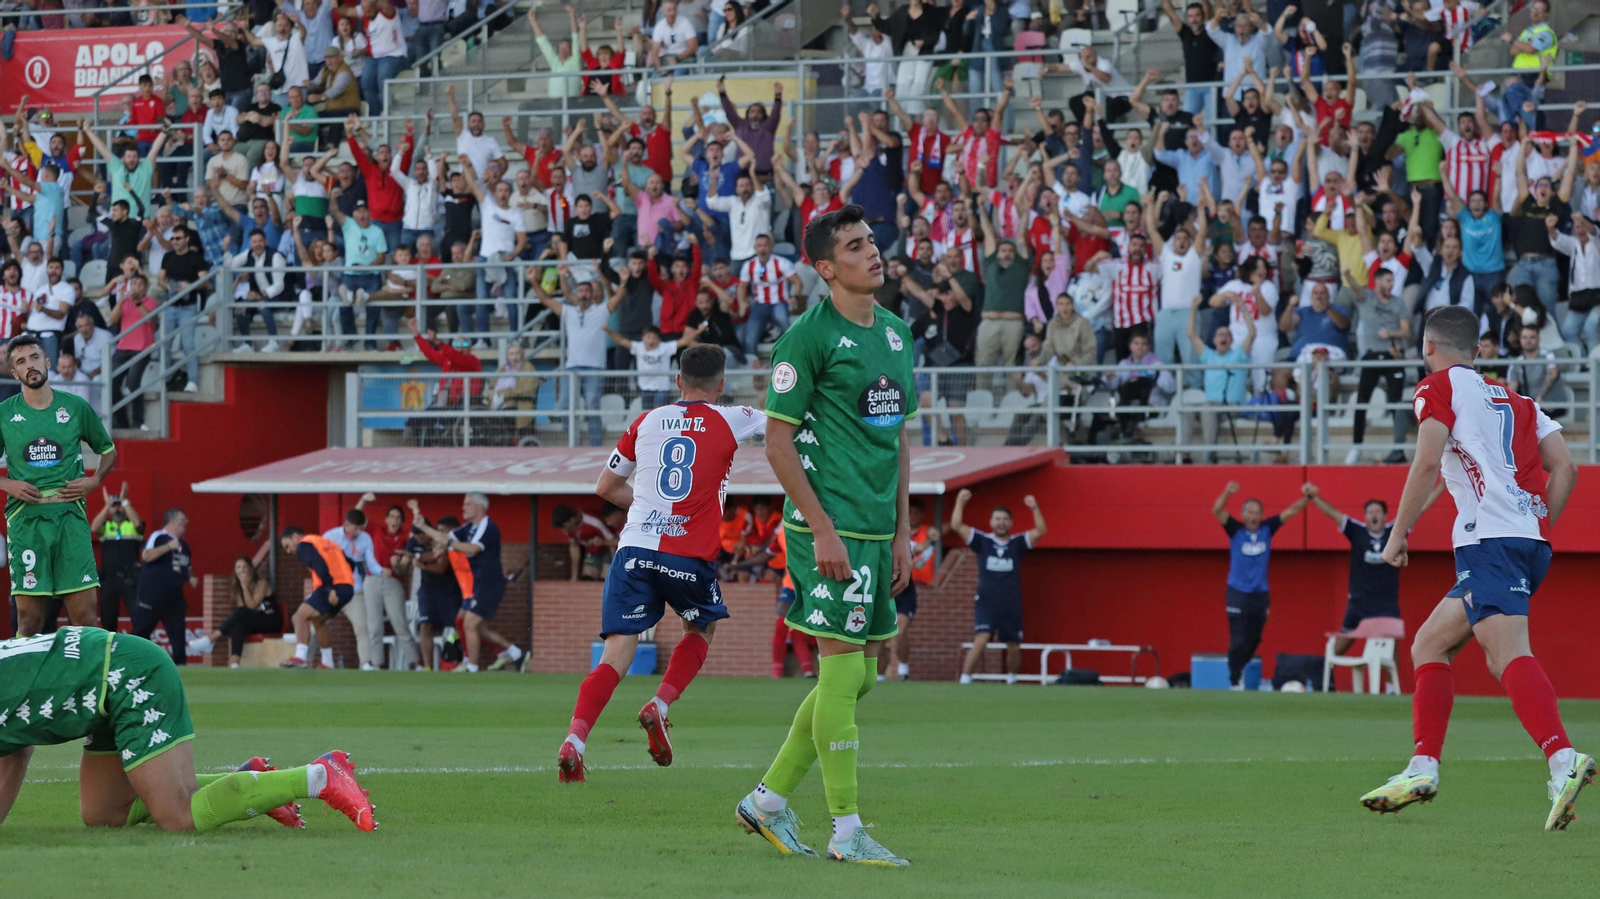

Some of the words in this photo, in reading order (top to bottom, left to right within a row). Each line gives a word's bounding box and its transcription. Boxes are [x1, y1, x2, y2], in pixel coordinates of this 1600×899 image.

[74, 40, 165, 67] APOLO
[867, 388, 900, 402] Estrella
[868, 400, 900, 415] Galicia
[660, 417, 691, 431] IVAN
[1484, 398, 1518, 472] 7
[28, 444, 57, 453] Estrella
[30, 451, 57, 461] Galicia
[609, 453, 621, 469] C
[656, 436, 697, 502] 8
[21, 549, 37, 572] 9
[637, 559, 697, 583] SEAPORTS
[842, 565, 873, 604] 22
